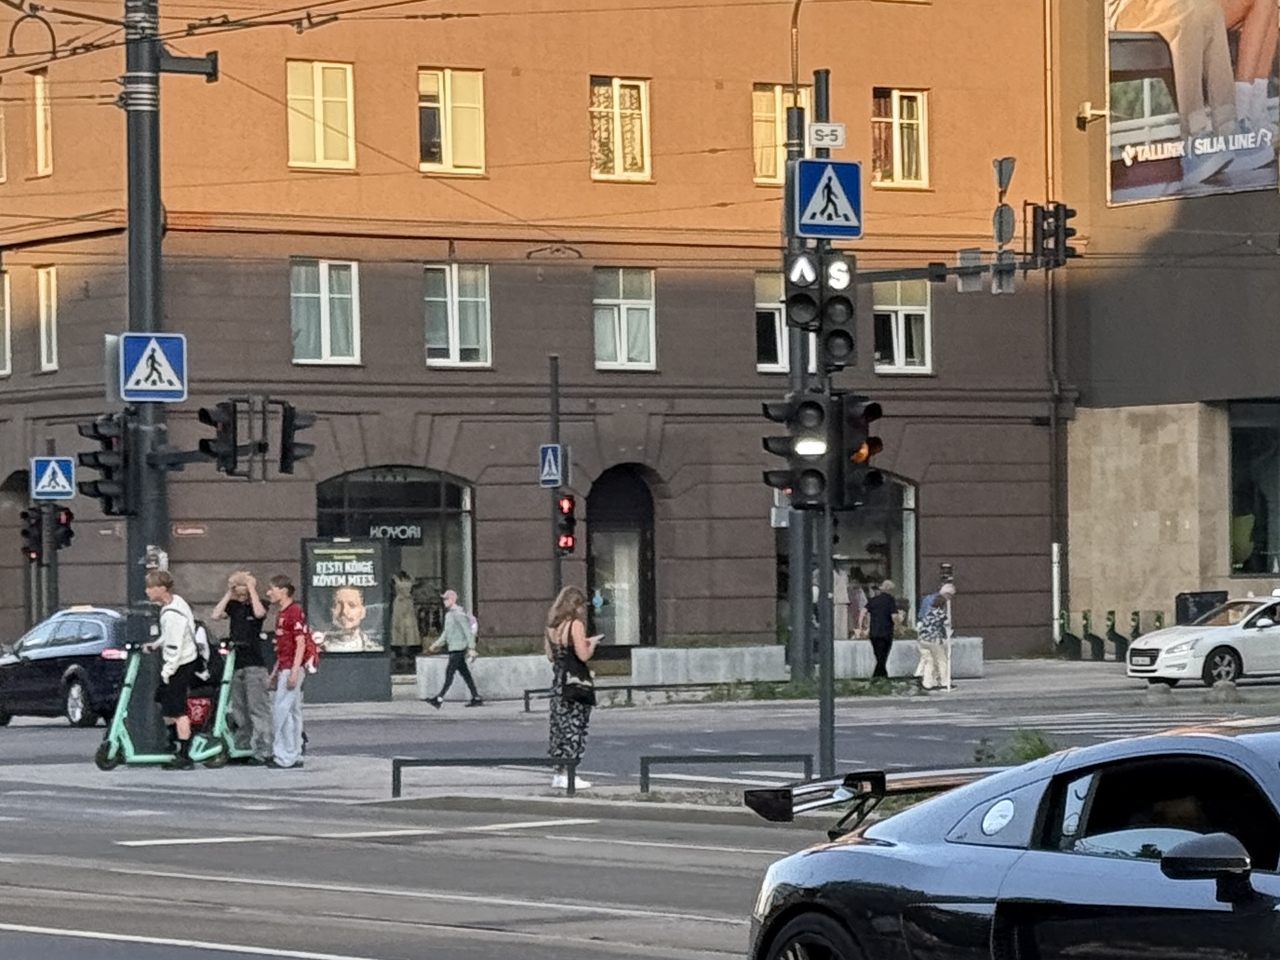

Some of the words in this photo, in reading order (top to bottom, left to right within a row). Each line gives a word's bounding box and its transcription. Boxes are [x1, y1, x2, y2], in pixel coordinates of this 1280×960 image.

[814, 129, 838, 142] S-5
[1136, 141, 1186, 162] TALLINK
[1194, 138, 1226, 155] SILJA
[1229, 133, 1256, 150] LINE
[370, 525, 421, 539] KOYORI
